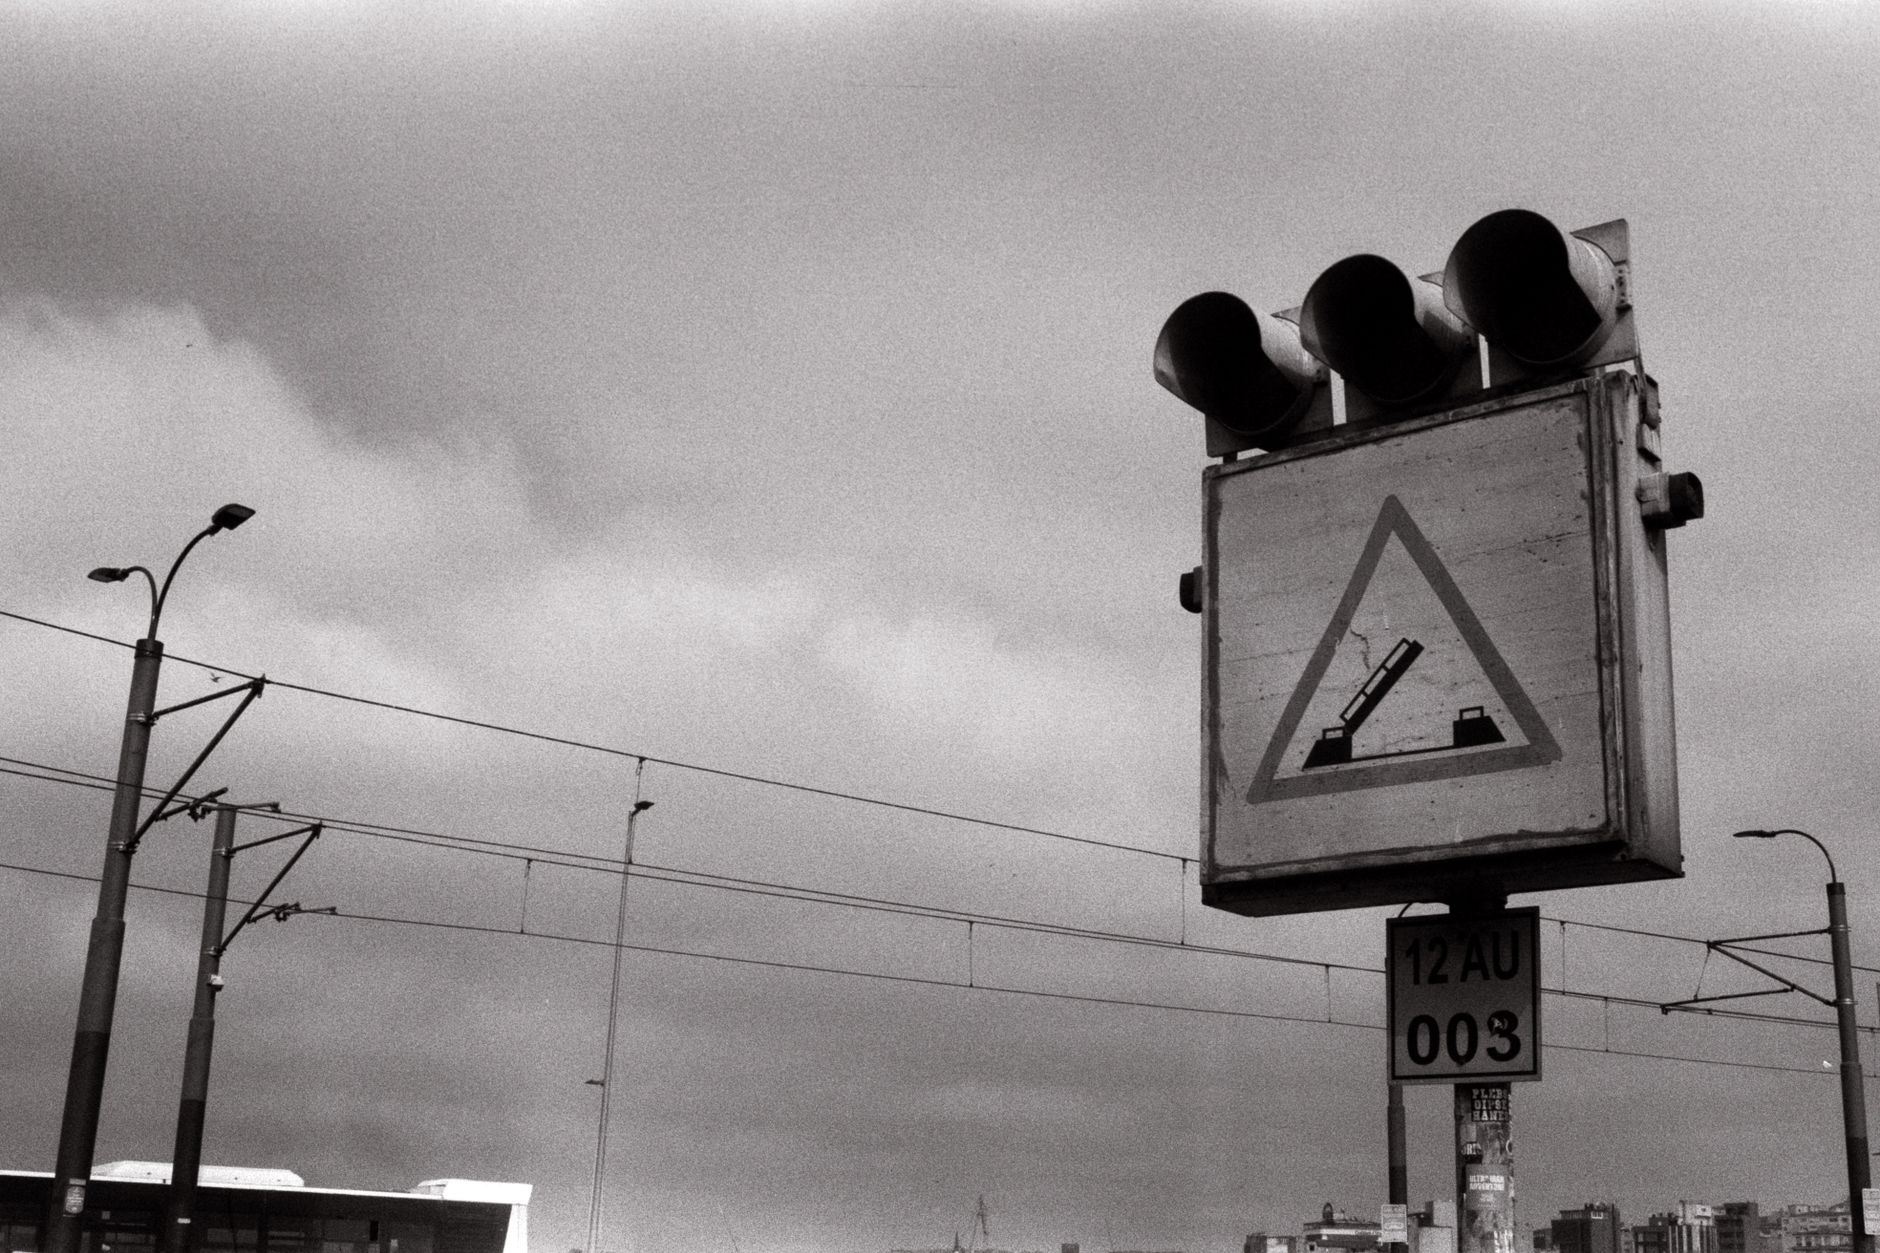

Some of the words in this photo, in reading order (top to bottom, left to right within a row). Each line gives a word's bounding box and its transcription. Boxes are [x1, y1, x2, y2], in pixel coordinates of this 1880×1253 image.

[1406, 936, 1449, 985] 12
[1460, 930, 1520, 983] AU
[1407, 1010, 1521, 1066] 003
